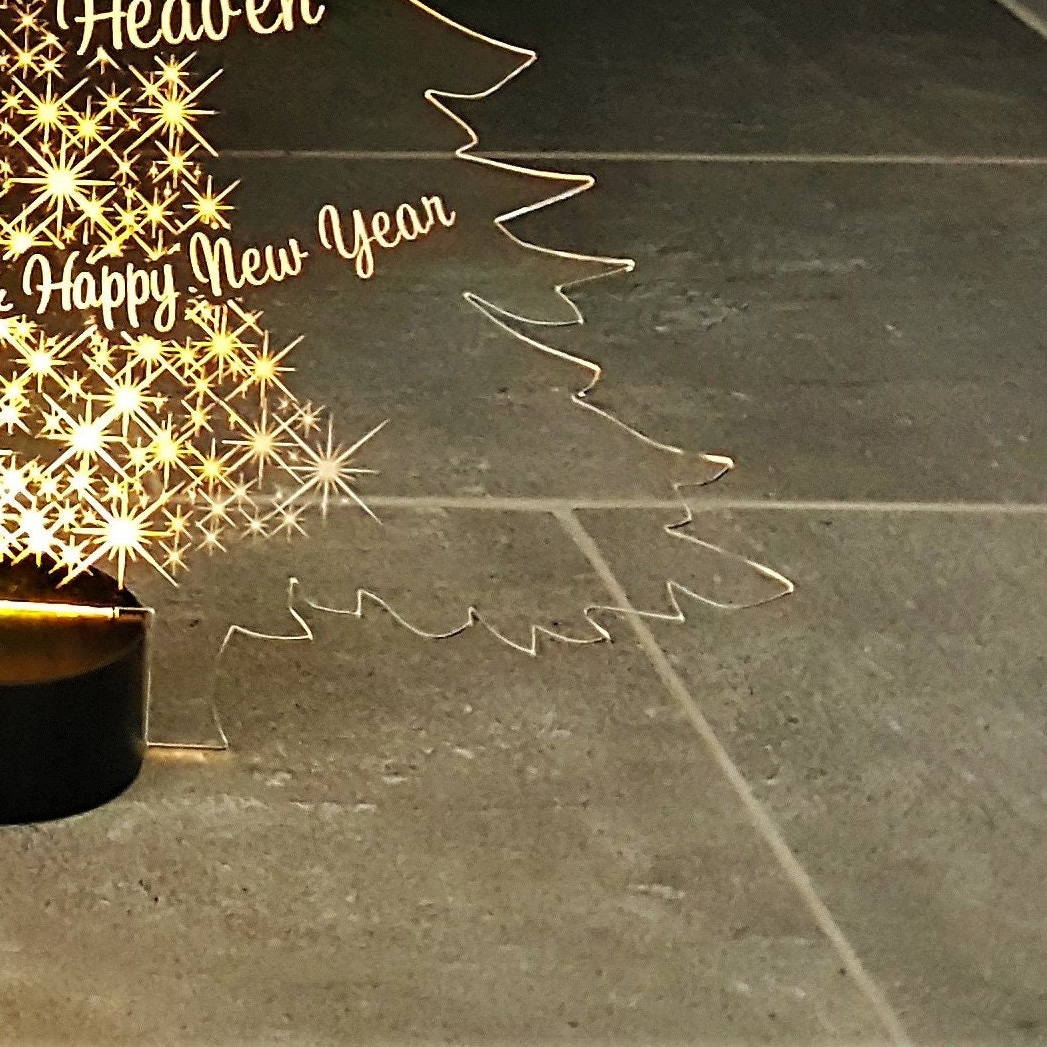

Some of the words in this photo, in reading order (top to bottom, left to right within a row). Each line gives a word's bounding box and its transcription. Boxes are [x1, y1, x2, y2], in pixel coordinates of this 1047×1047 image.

[22, 251, 179, 332] Happy
[189, 232, 309, 296] New
[318, 195, 456, 280] Year
